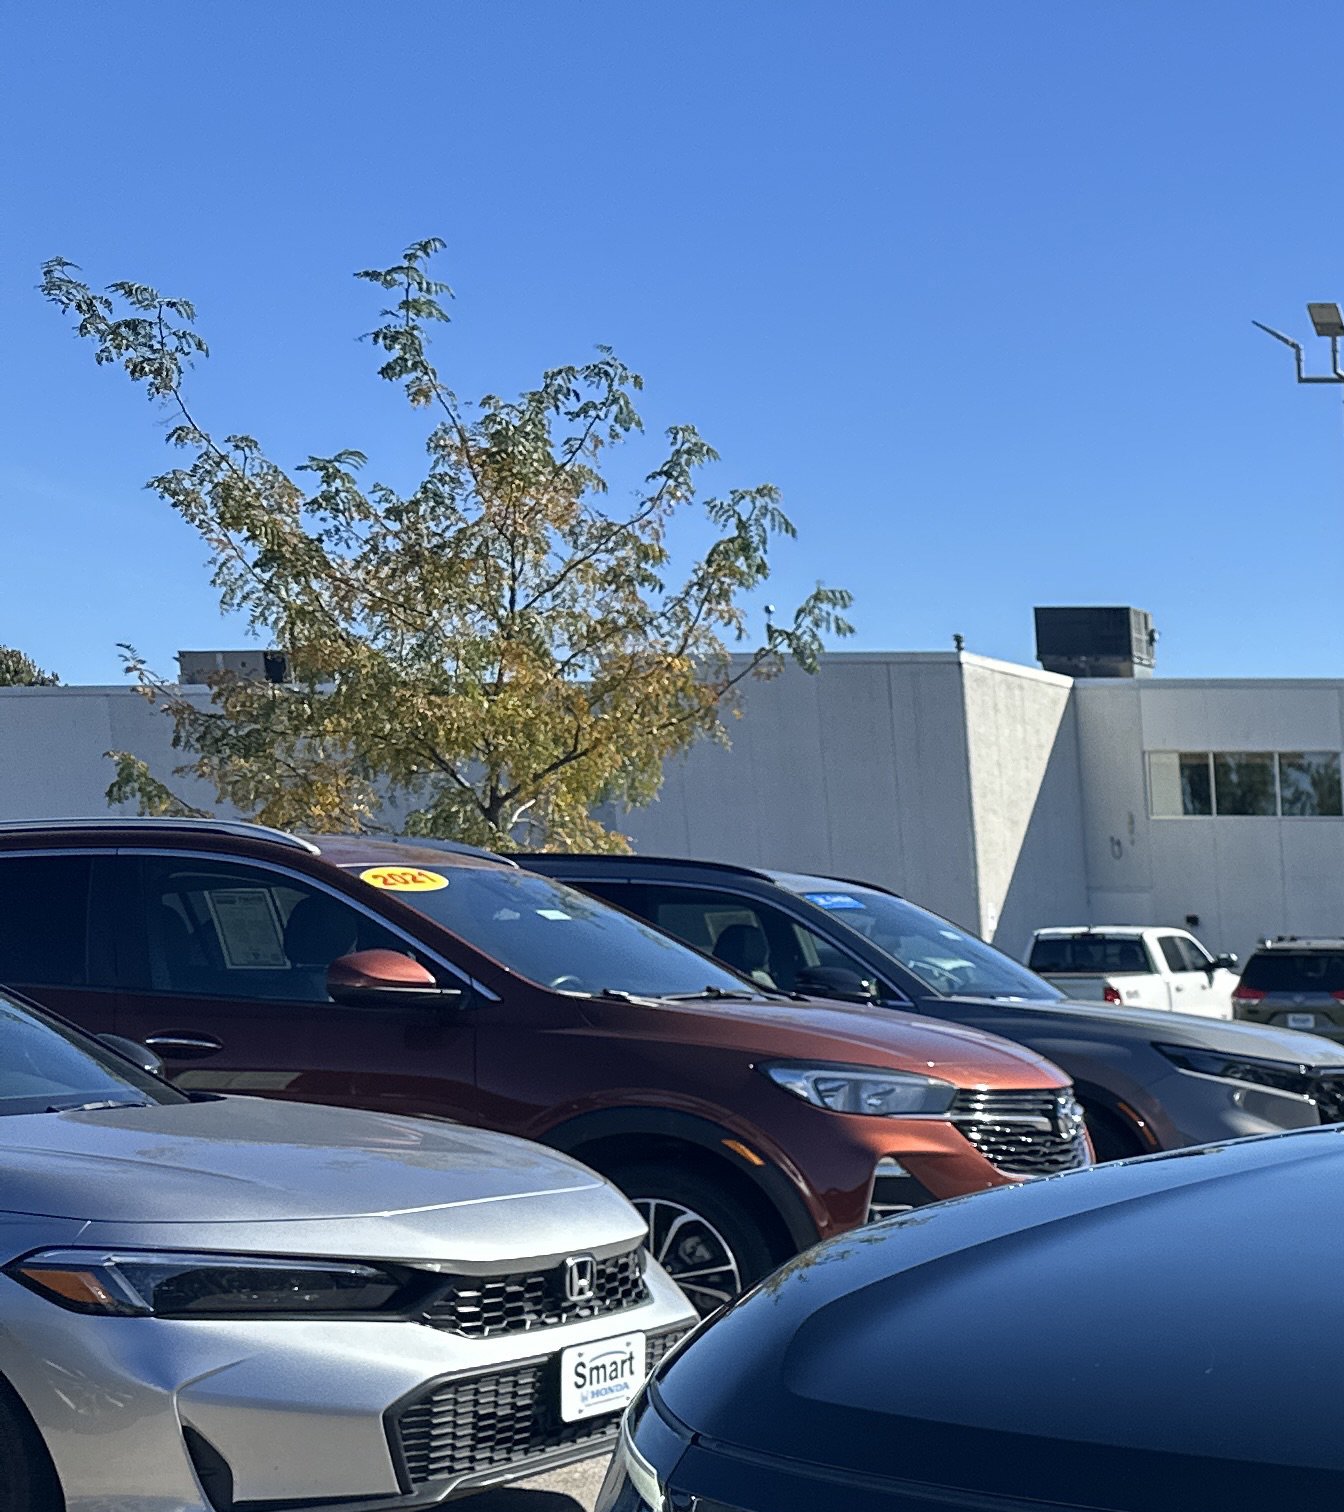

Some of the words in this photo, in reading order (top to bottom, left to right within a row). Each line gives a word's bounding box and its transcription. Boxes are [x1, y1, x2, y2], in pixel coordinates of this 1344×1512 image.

[371, 871, 437, 886] 2021
[574, 1351, 635, 1389] Smart
[590, 1381, 630, 1399] HONDA
